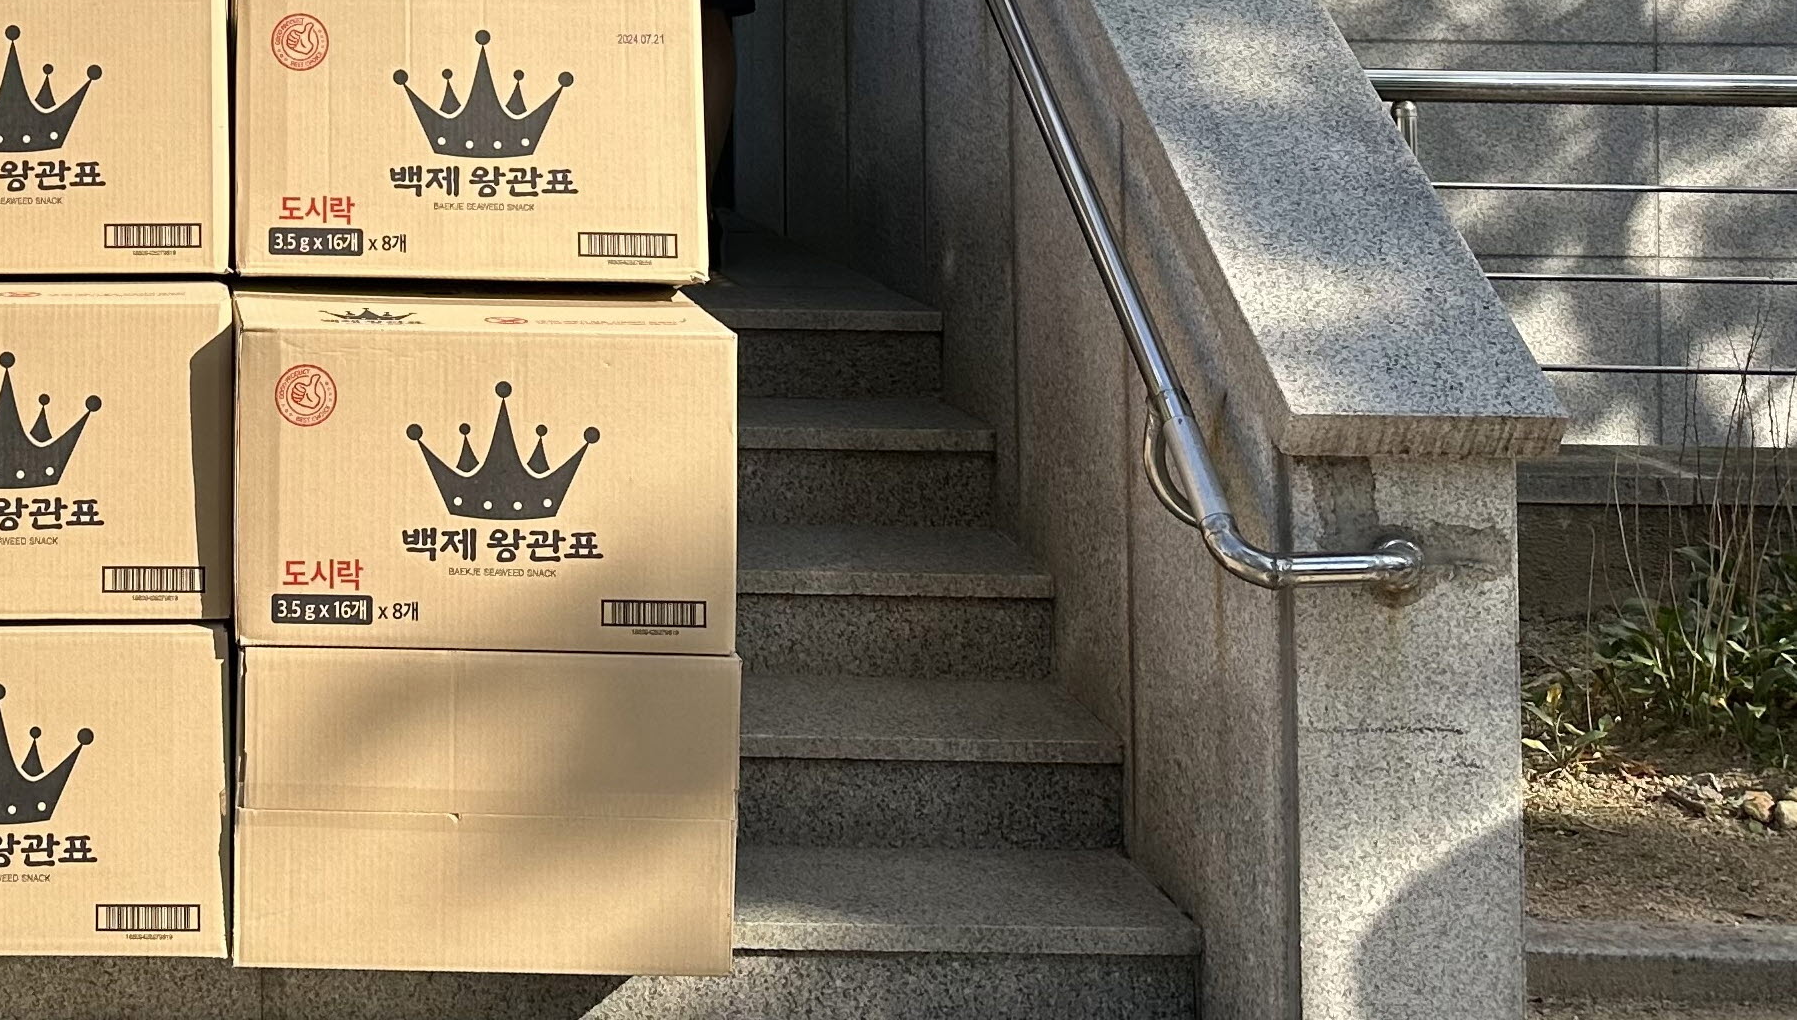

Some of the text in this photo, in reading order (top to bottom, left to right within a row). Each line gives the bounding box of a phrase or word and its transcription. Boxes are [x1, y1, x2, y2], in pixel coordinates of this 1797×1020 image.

[389, 165, 579, 198] 백제 왕관표
[278, 196, 355, 225] 도시락
[29, 537, 58, 546] SNACK
[402, 528, 604, 562] 백제 왕관표
[282, 559, 363, 591] 도시락
[276, 600, 302, 619] 3.5
[333, 601, 367, 621] 16개
[392, 602, 419, 622] 8개
[21, 874, 50, 883] SNACK
